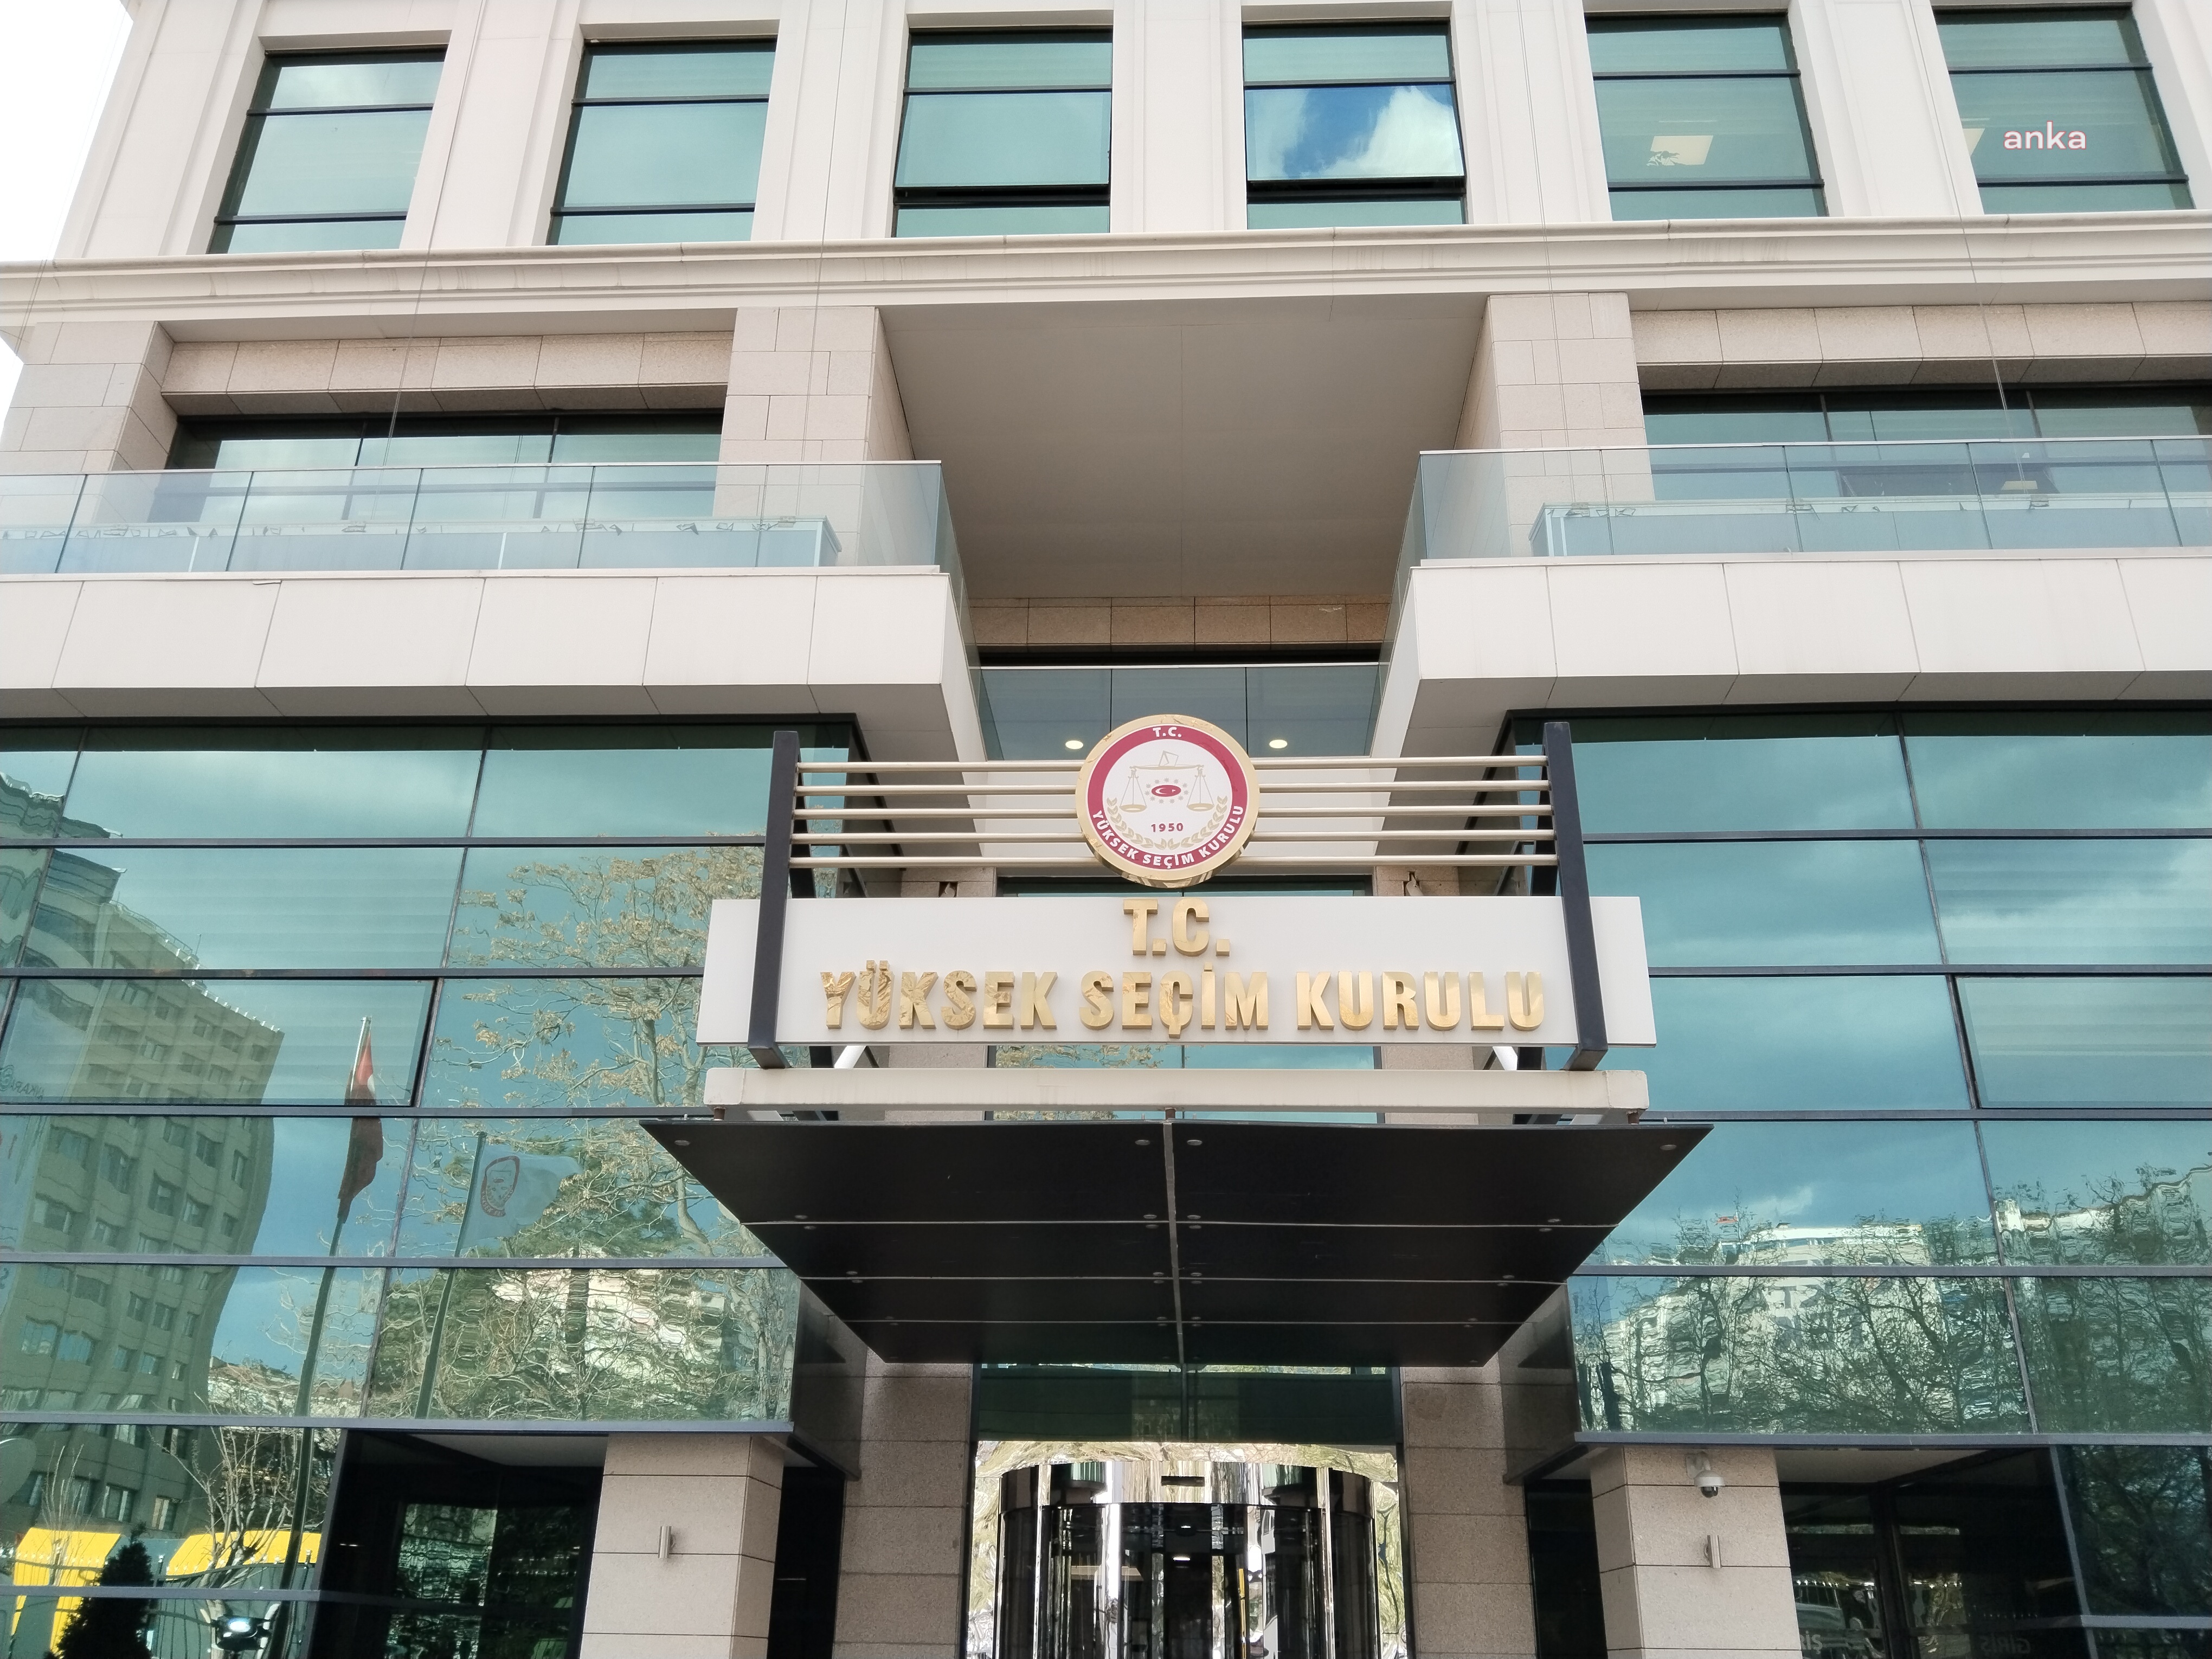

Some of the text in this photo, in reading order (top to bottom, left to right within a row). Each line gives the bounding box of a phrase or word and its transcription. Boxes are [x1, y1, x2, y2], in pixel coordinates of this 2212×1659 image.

[1152, 726, 1182, 737] T.C.
[1092, 806, 1243, 869] YÜKSEK SEÇİM KURULU
[1151, 822, 1184, 832] 1950
[1123, 898, 1230, 956] T.C.
[820, 960, 1544, 1038] YÜKSEK SEÇİM KURULU
